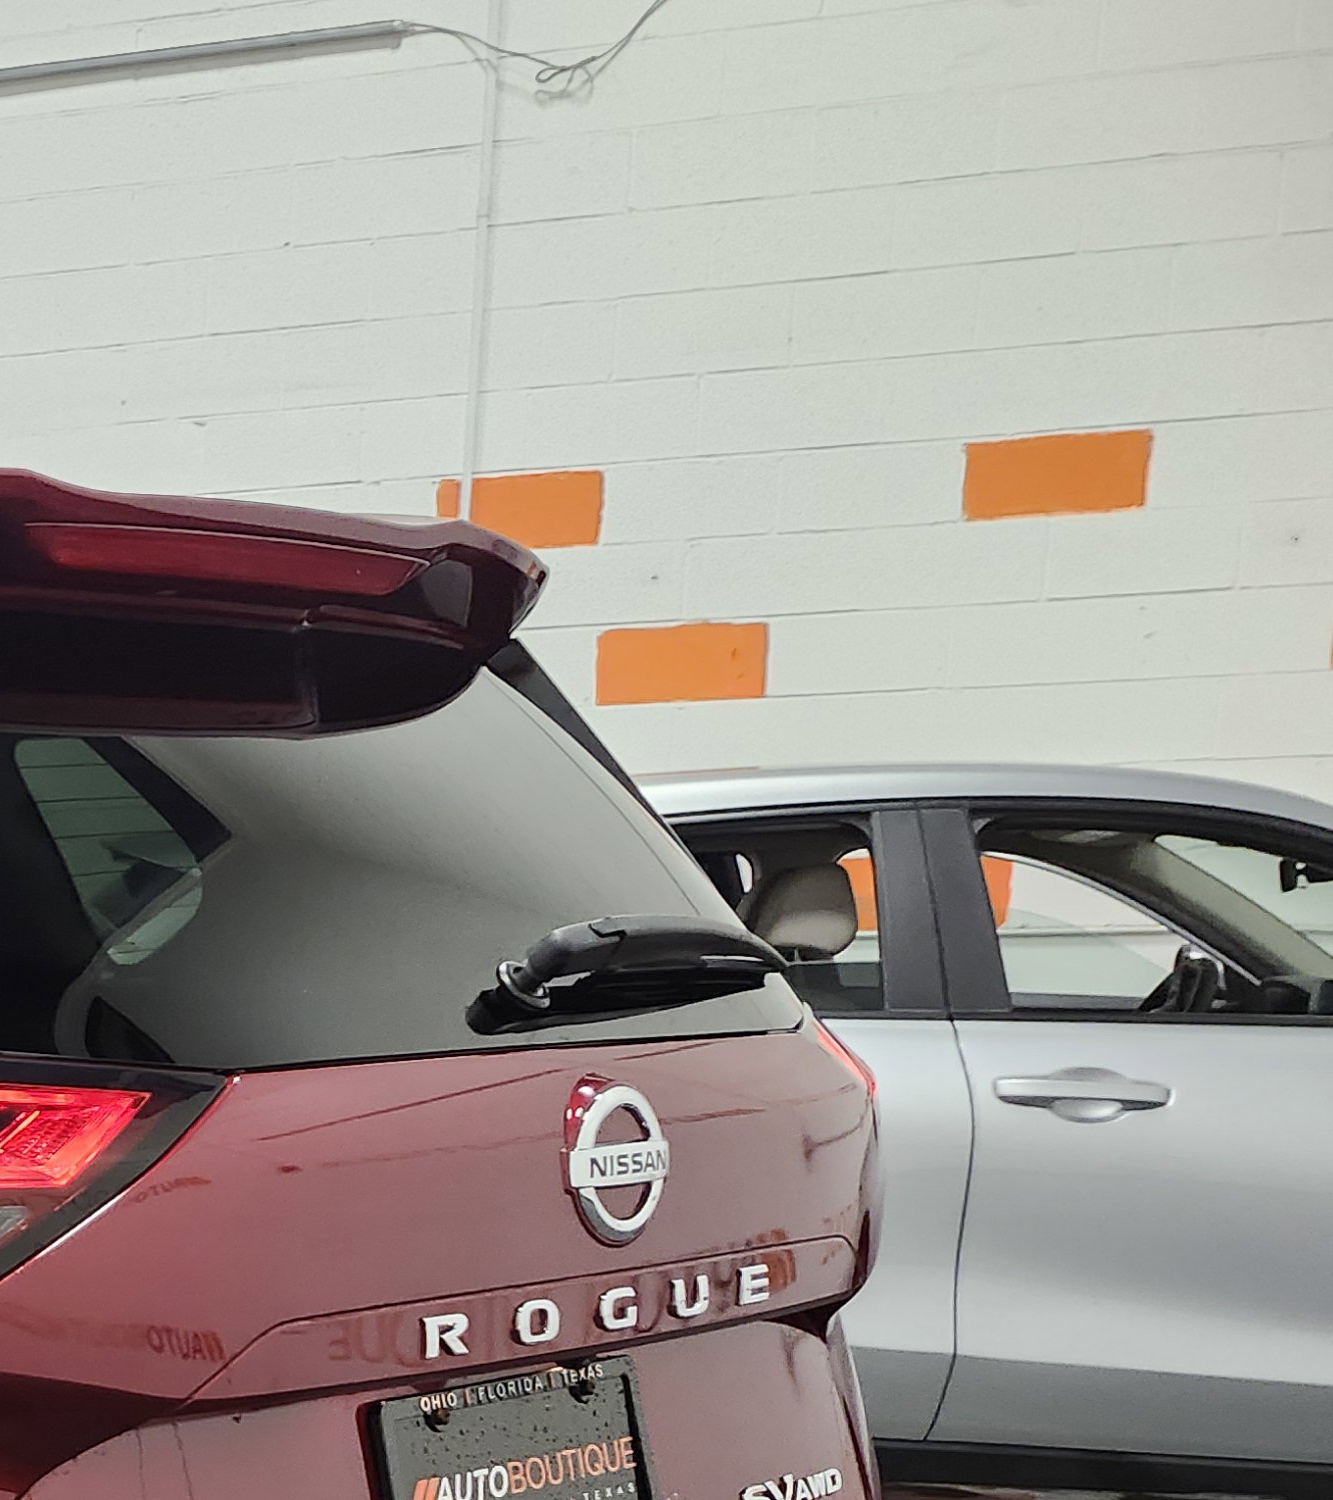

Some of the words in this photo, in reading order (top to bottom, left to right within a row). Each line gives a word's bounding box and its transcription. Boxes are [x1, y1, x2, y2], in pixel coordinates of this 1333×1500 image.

[589, 1149, 667, 1178] NISSAN
[420, 1263, 771, 1360] ROGUE
[419, 1391, 458, 1413] OHIO
[476, 1376, 544, 1402] FLORIDA
[562, 1363, 605, 1386] TEXAS
